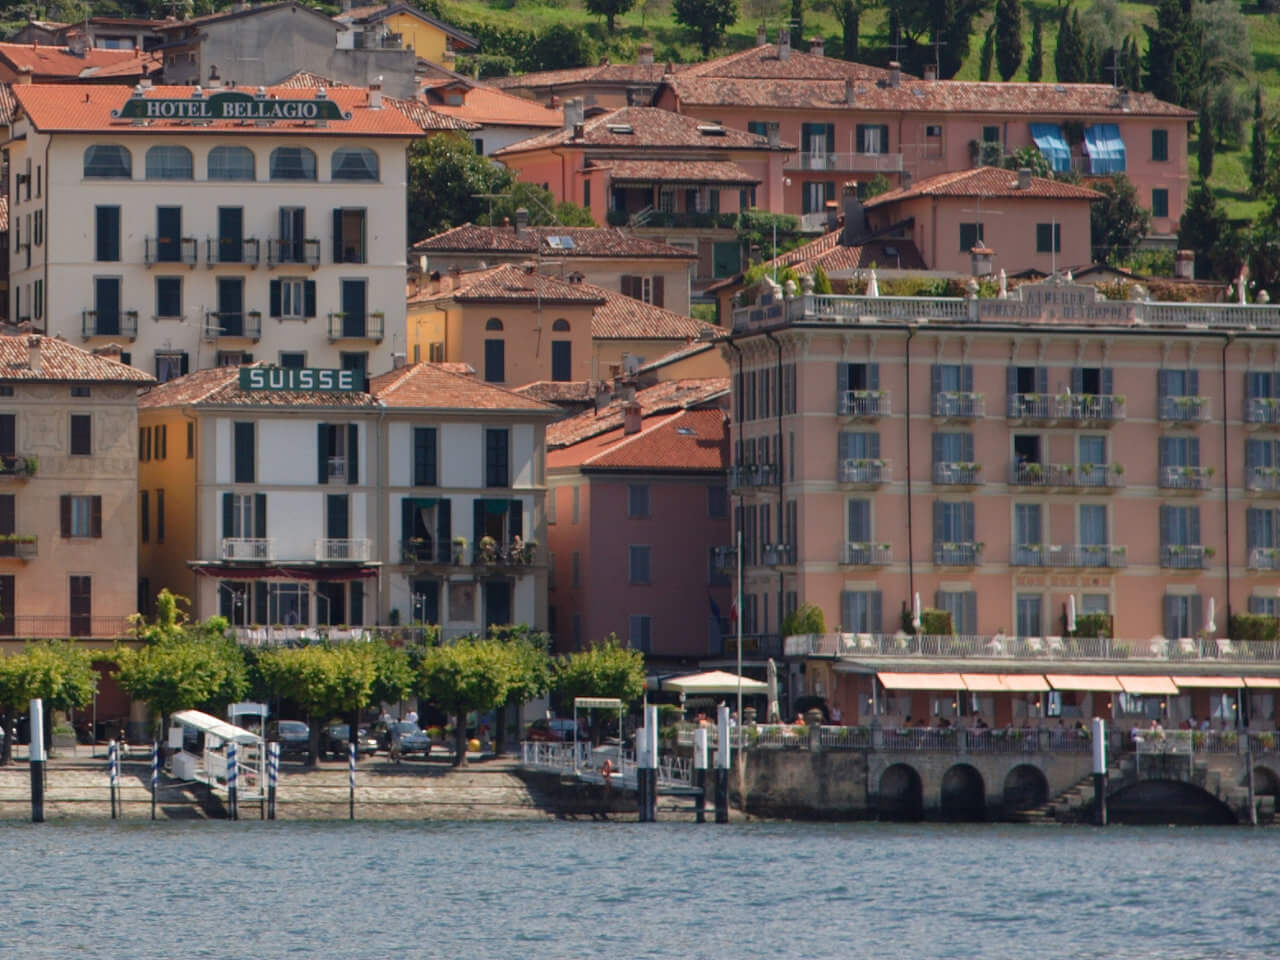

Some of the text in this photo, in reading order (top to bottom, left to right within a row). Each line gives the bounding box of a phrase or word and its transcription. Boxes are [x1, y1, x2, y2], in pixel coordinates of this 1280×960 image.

[146, 102, 318, 118] HOTEL BELLAGIO
[250, 369, 353, 389] SUISSE
